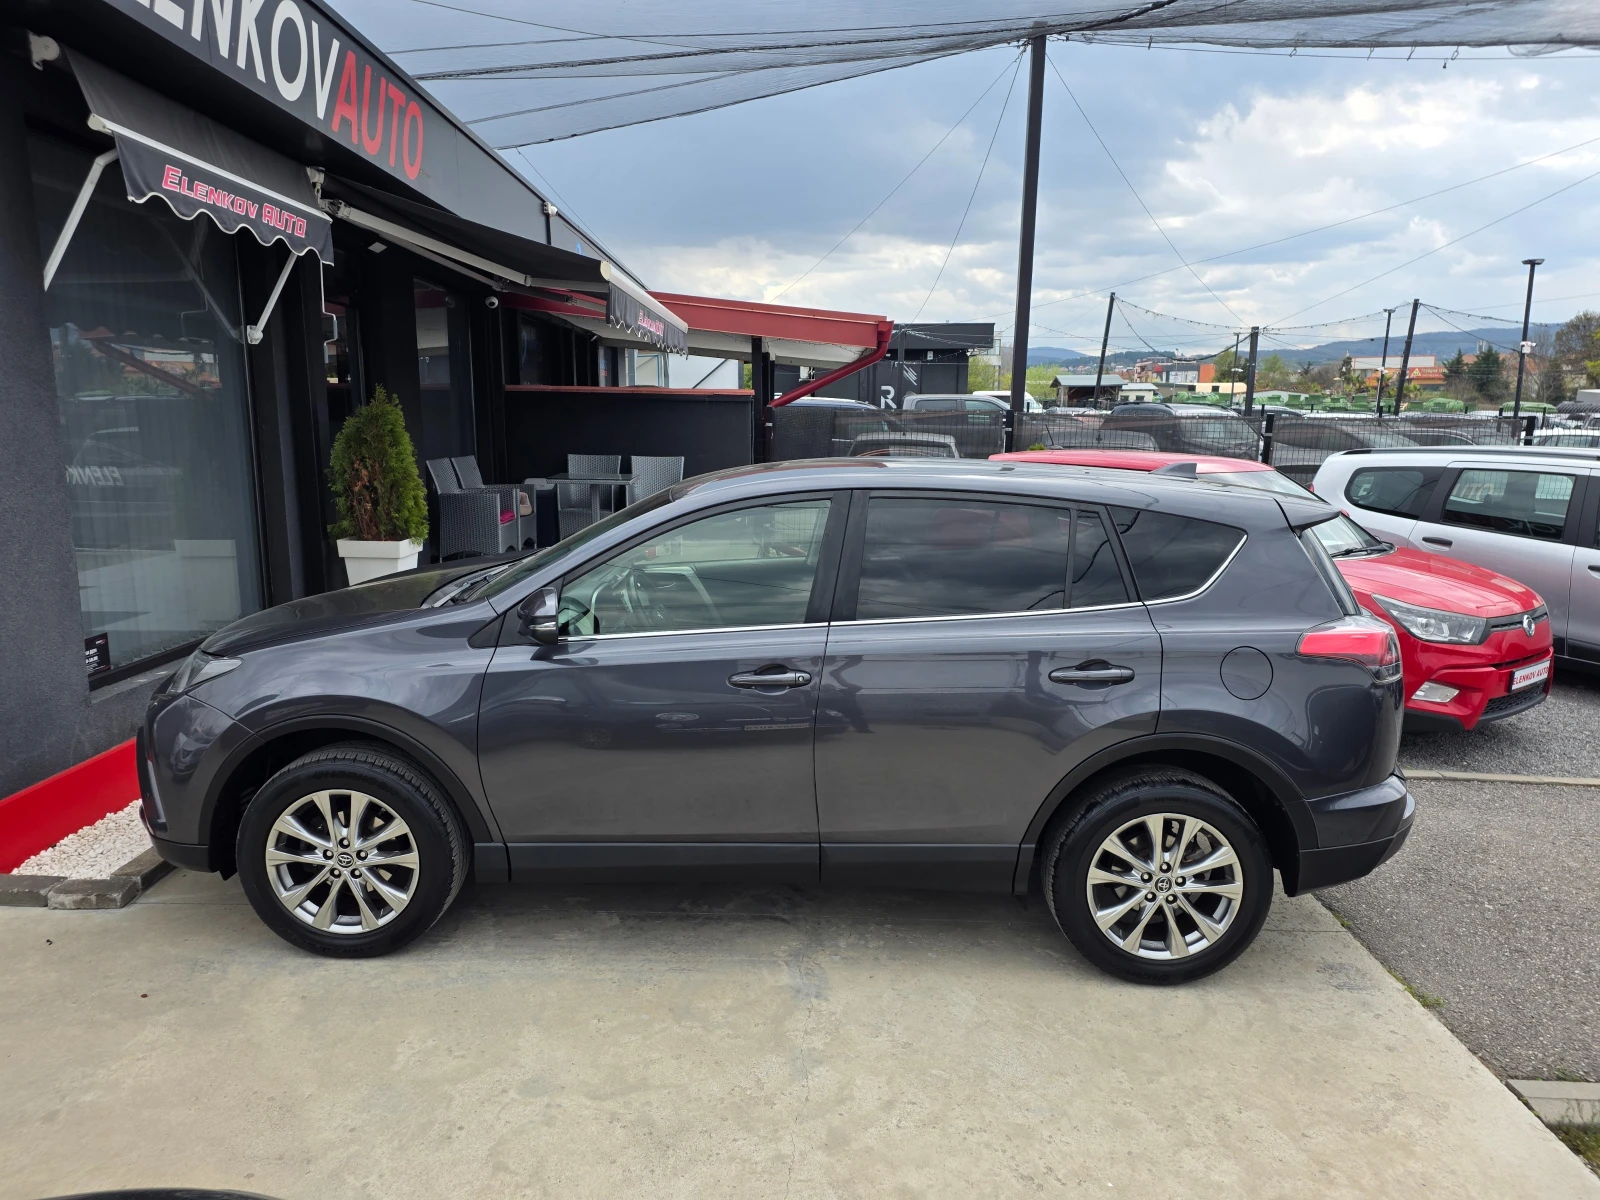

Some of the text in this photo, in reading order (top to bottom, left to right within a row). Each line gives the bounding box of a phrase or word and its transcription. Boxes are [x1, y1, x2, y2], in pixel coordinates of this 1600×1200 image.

[331, 50, 424, 181] AUTO
[162, 164, 307, 238] ELENKOV AUTO
[1512, 666, 1549, 685] ELENKOV AUTO
